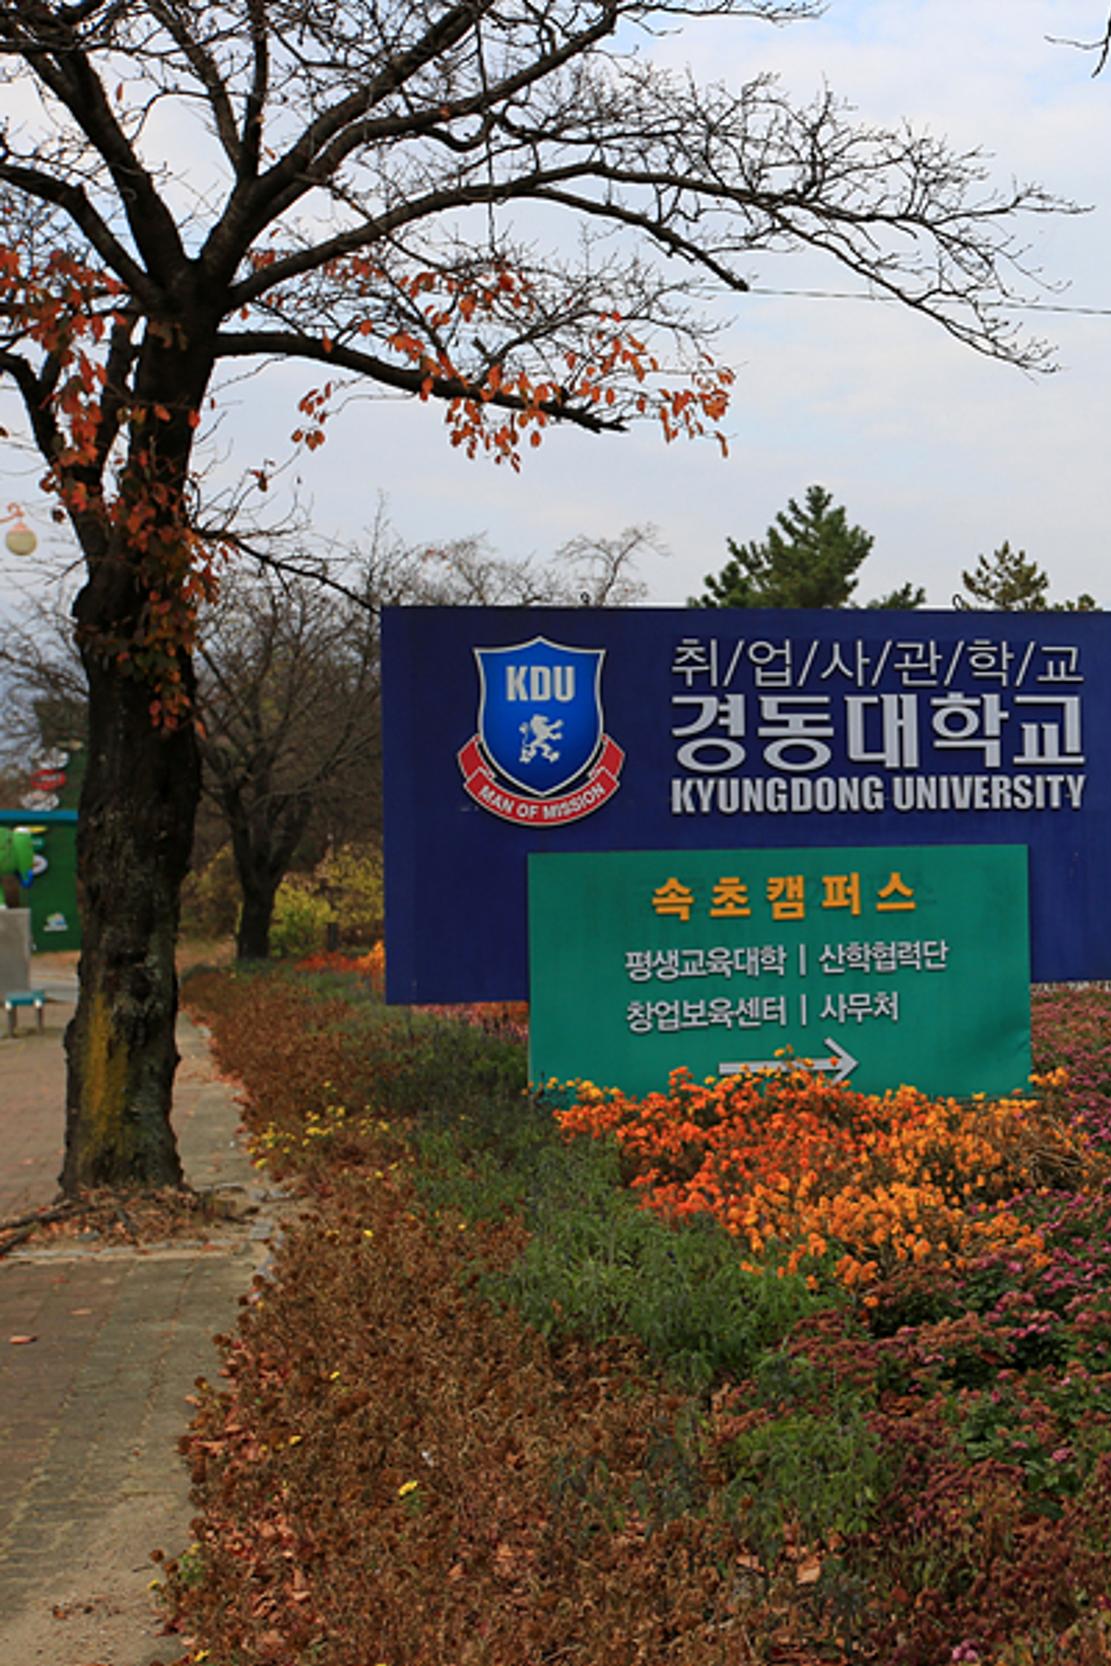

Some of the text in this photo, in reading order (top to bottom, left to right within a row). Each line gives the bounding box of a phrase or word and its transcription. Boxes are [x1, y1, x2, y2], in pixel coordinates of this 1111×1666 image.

[506, 665, 575, 701] KDU
[671, 639, 1085, 688] 취/업/사/관/학/교
[671, 692, 1086, 773] 경동대학교
[479, 782, 607, 819] MAN OF MISSION
[671, 775, 1086, 813] KYUNGDONG UNIVERSITY
[652, 871, 917, 921] 속초캠퍼스
[625, 939, 949, 982] 평생교육대학 산학협력단
[626, 992, 900, 1033] 창업보육센터 사무처
